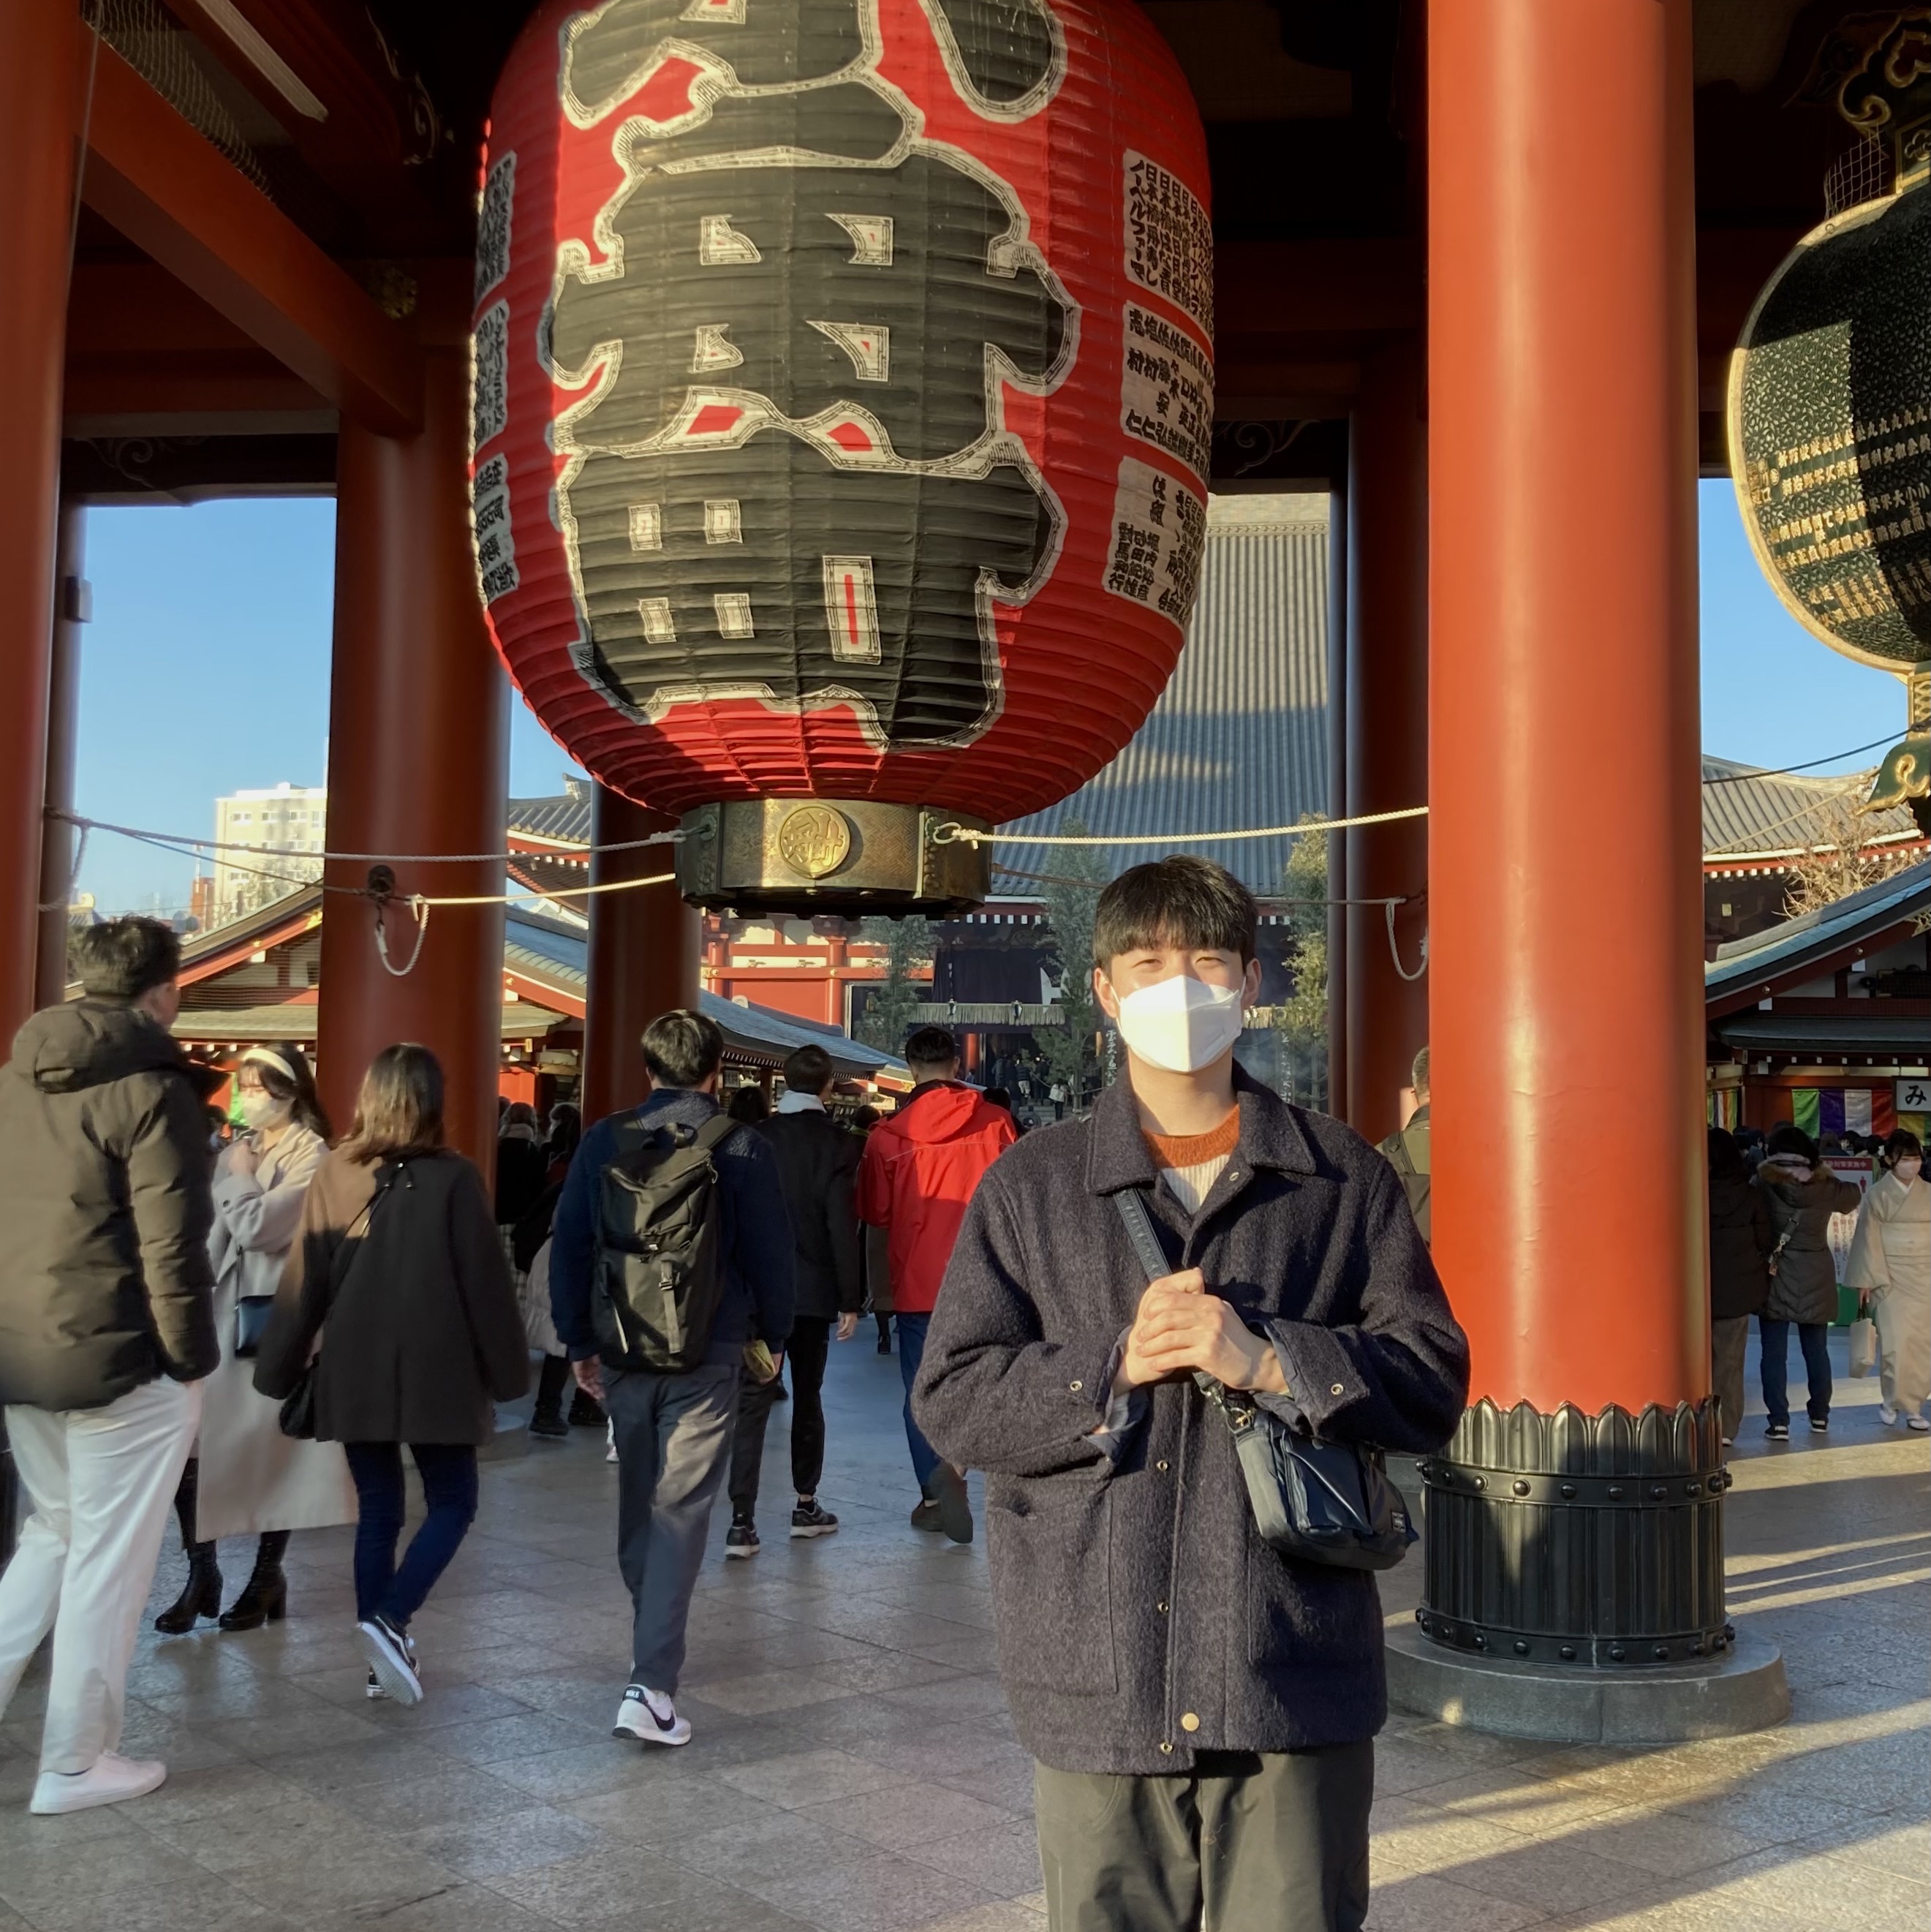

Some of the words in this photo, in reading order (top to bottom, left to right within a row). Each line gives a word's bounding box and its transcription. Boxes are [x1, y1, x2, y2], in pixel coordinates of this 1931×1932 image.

[1130, 160, 1146, 282] ノーベルファーマ
[1905, 1085, 1927, 1106] み
